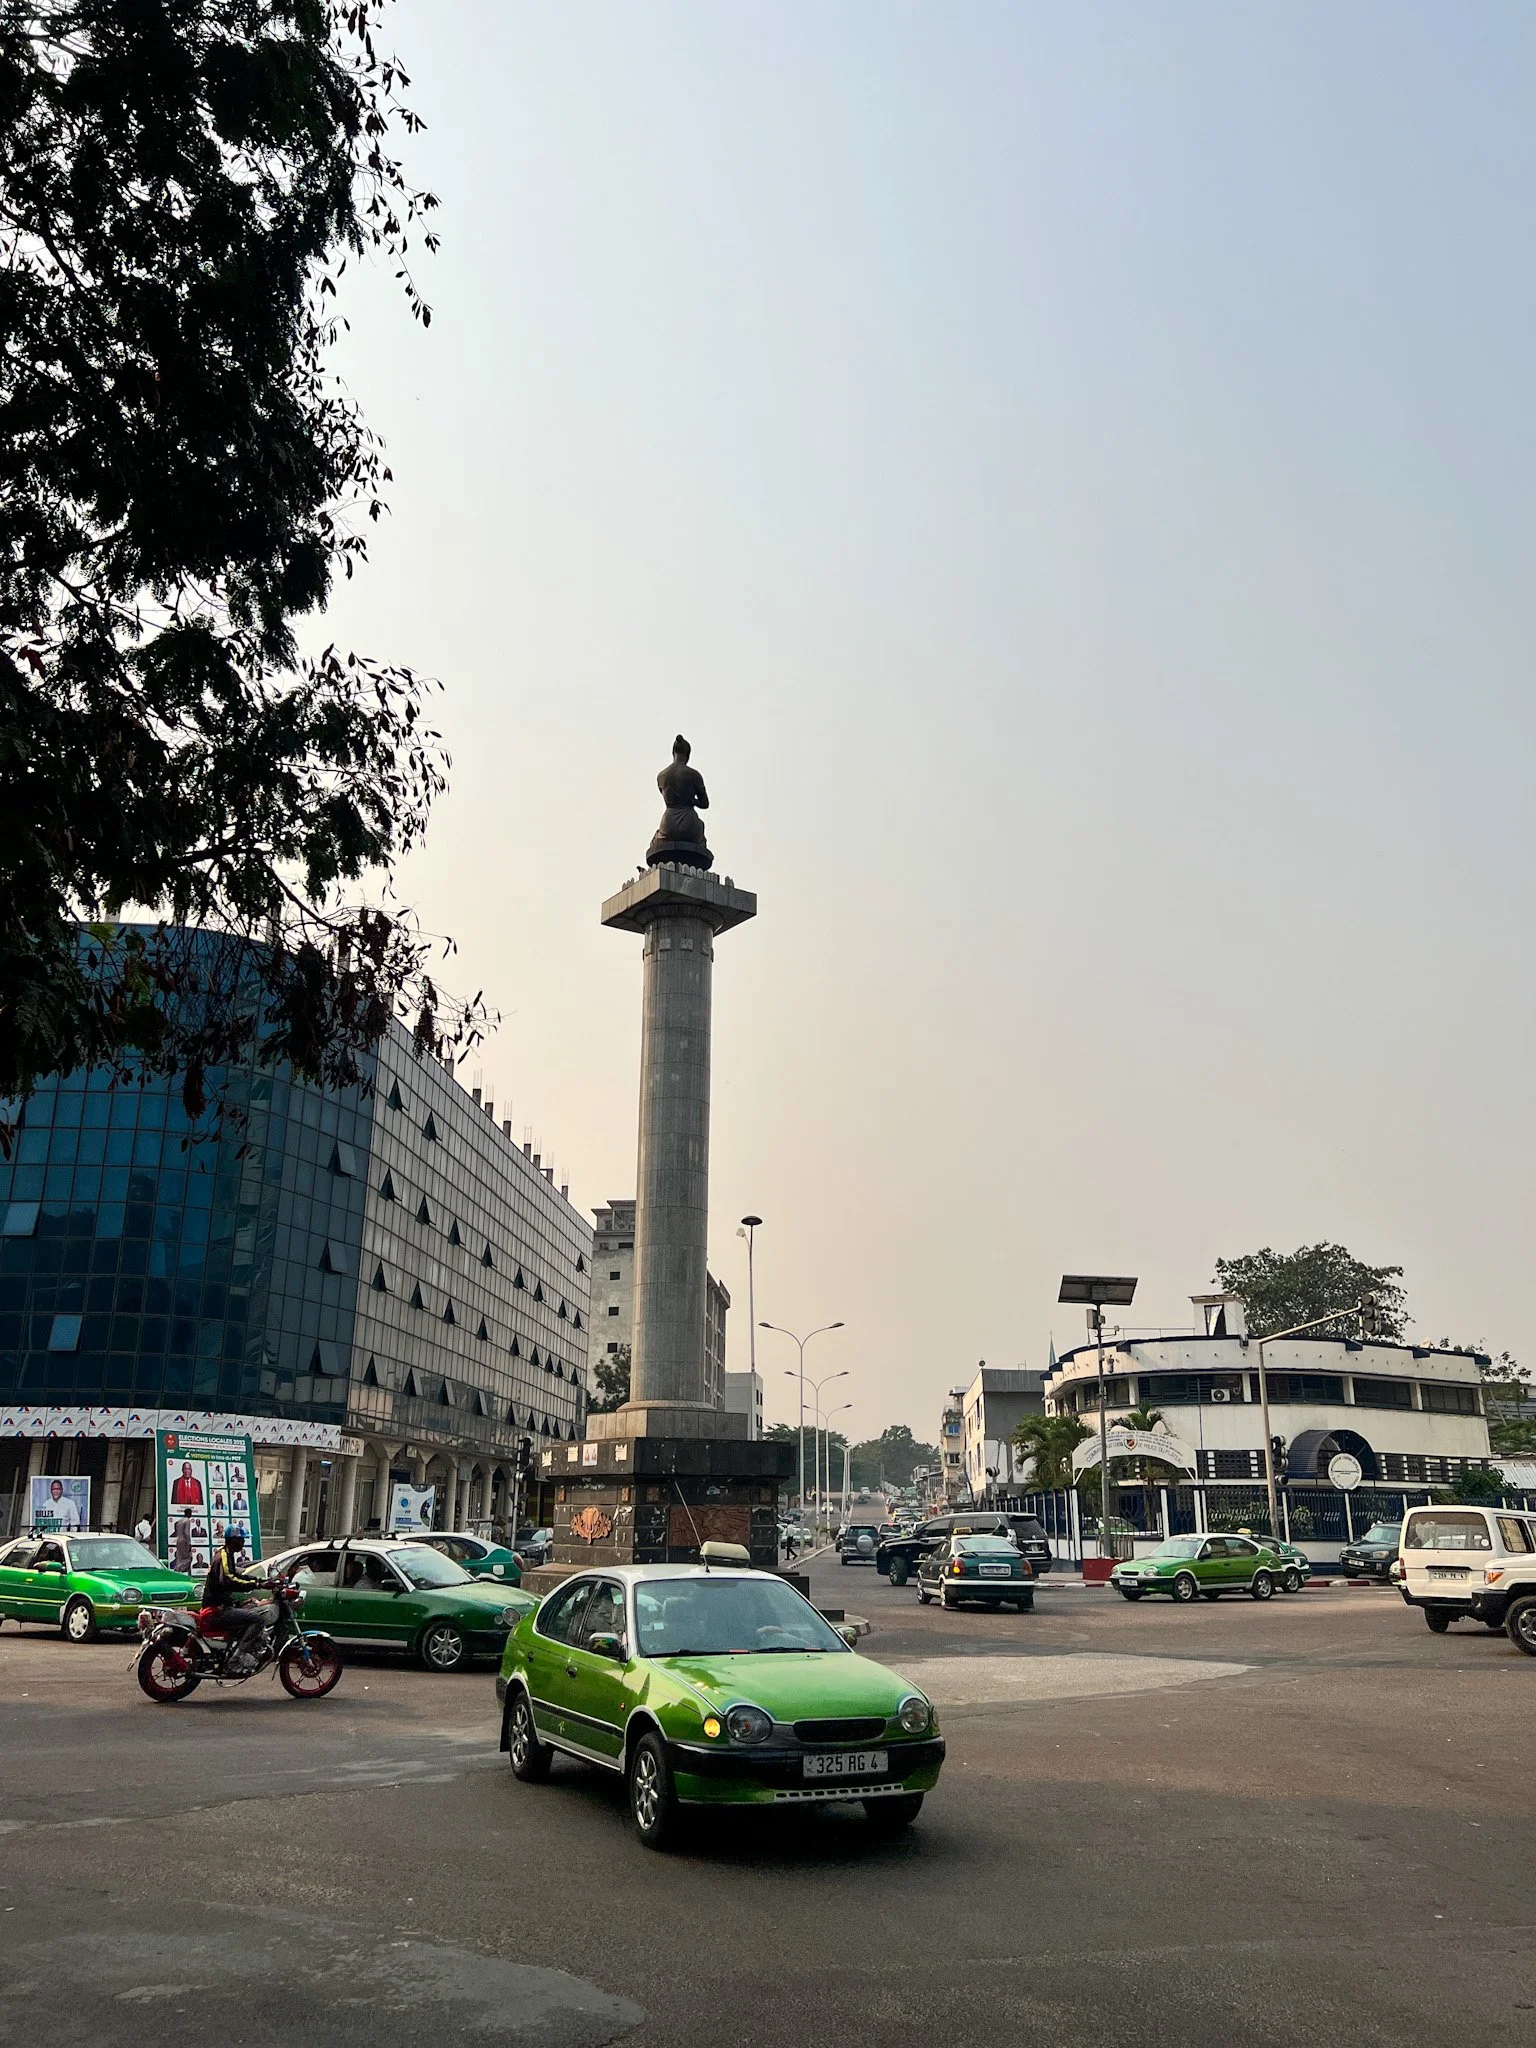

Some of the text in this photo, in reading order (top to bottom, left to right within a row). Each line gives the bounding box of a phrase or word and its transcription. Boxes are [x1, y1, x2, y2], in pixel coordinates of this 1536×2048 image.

[178, 1434, 208, 1443] ELECTIONS
[209, 1437, 233, 1445] LOCALES
[816, 1756, 843, 1774] 325
[870, 1753, 878, 1769] 4
